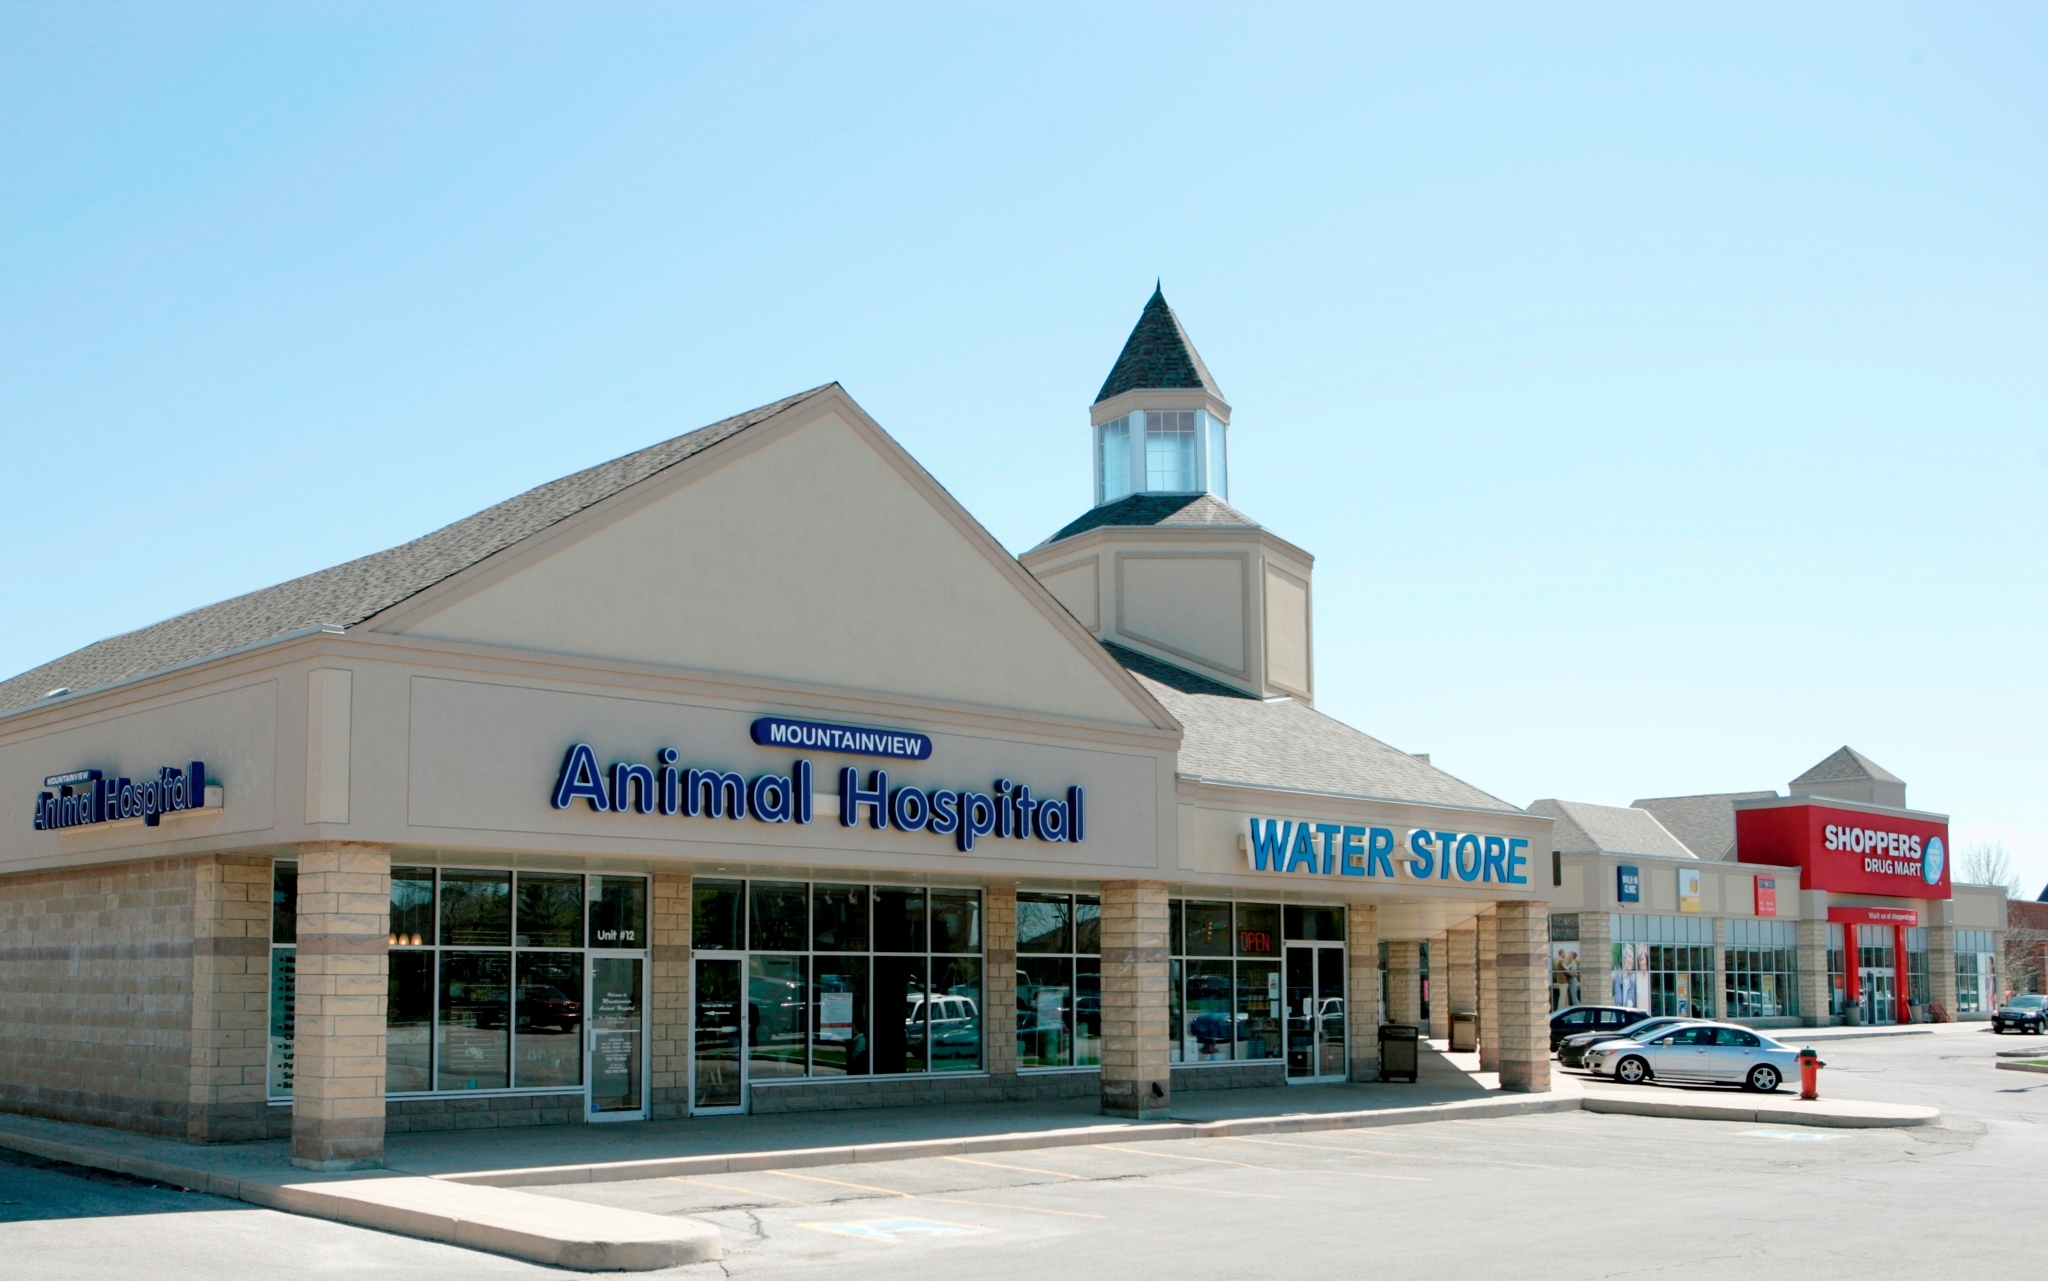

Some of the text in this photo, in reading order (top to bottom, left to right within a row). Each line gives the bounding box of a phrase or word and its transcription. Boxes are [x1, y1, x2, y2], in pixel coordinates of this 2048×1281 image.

[771, 724, 921, 756] MOUNTAINVIEW
[47, 771, 89, 786] MOUNTAINVIEW
[34, 761, 197, 830] Animal Hospital
[551, 743, 1085, 852] Animal Hospital
[1247, 818, 1529, 885] WATER STORE
[1824, 824, 1921, 859] SHOPPERS
[1864, 857, 1921, 877] DRUG MART
[1622, 875, 1639, 885] WALK-IN
[1624, 884, 1637, 894] CLINIC
[1868, 911, 1880, 920] Visit
[597, 929, 635, 941] Unit #12
[1240, 931, 1270, 952] OPEN
